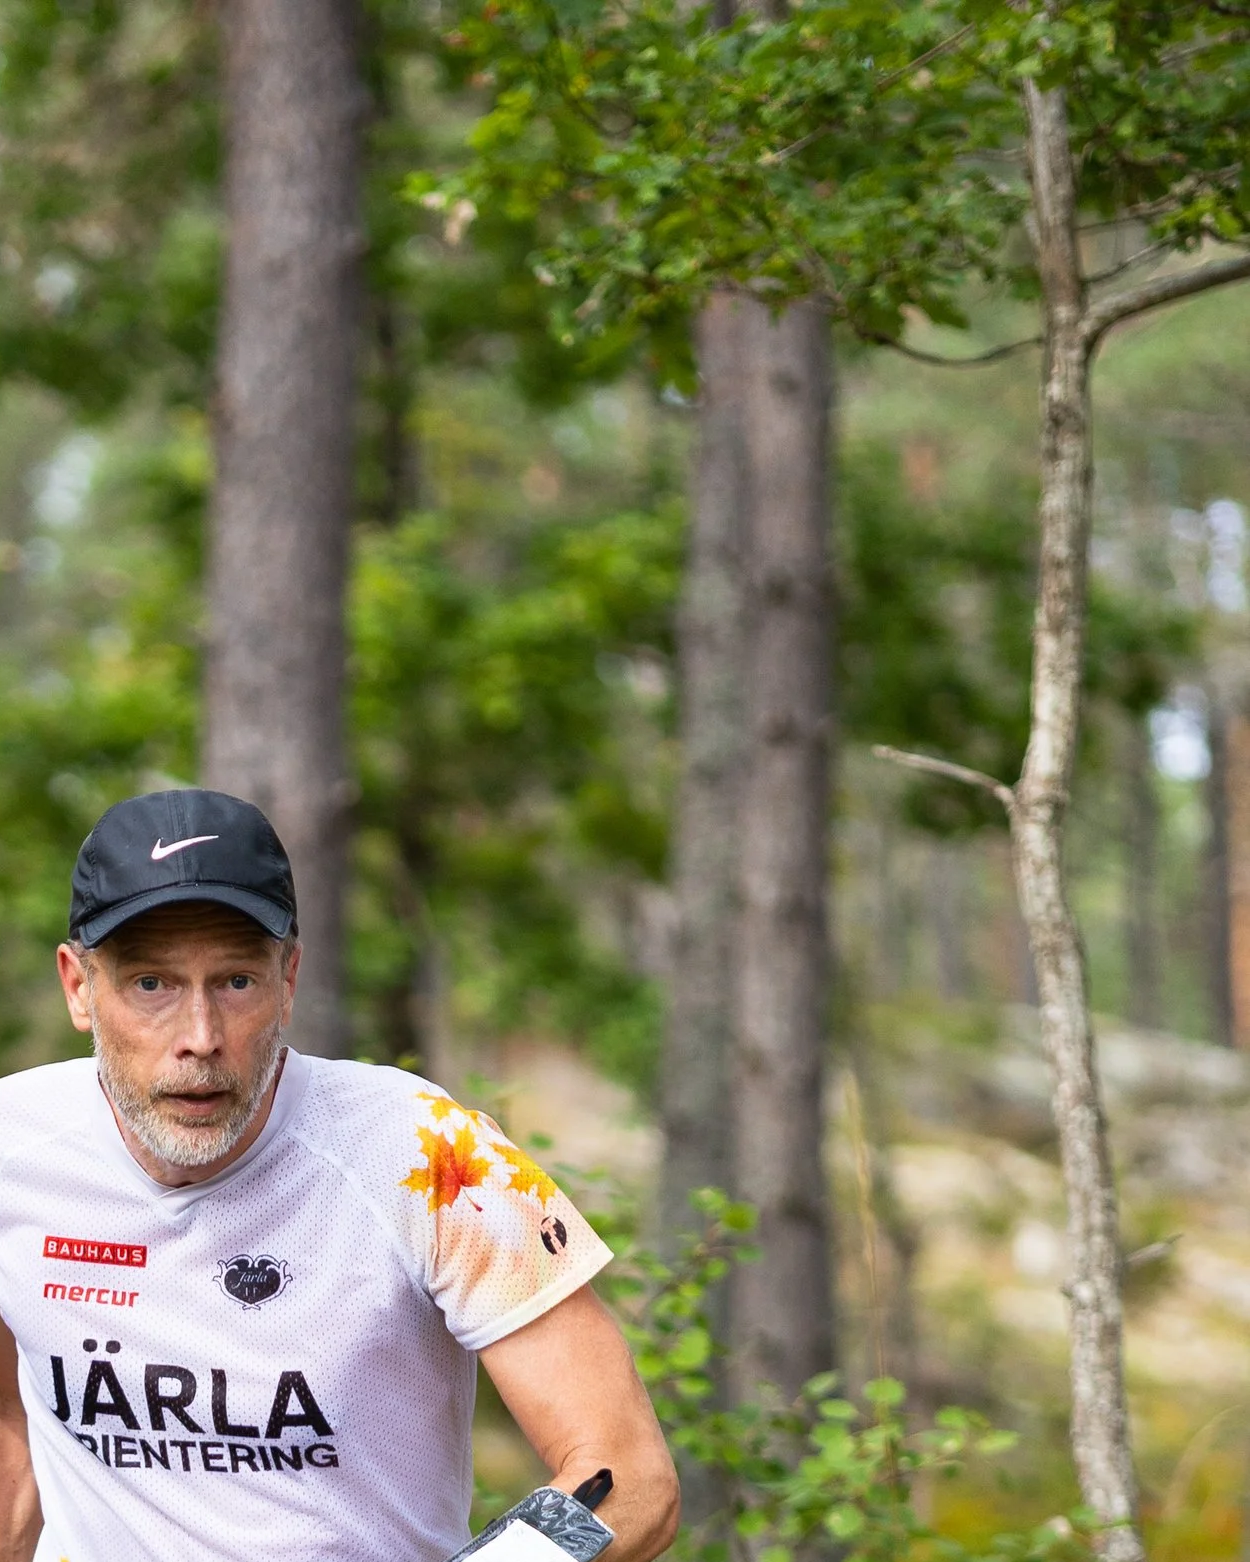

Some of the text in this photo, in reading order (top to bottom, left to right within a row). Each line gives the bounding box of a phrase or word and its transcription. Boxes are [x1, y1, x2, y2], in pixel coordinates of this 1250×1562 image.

[47, 1240, 144, 1262] BAUHAUS
[43, 1283, 139, 1307] mercur
[49, 1338, 335, 1440] JÄRLA
